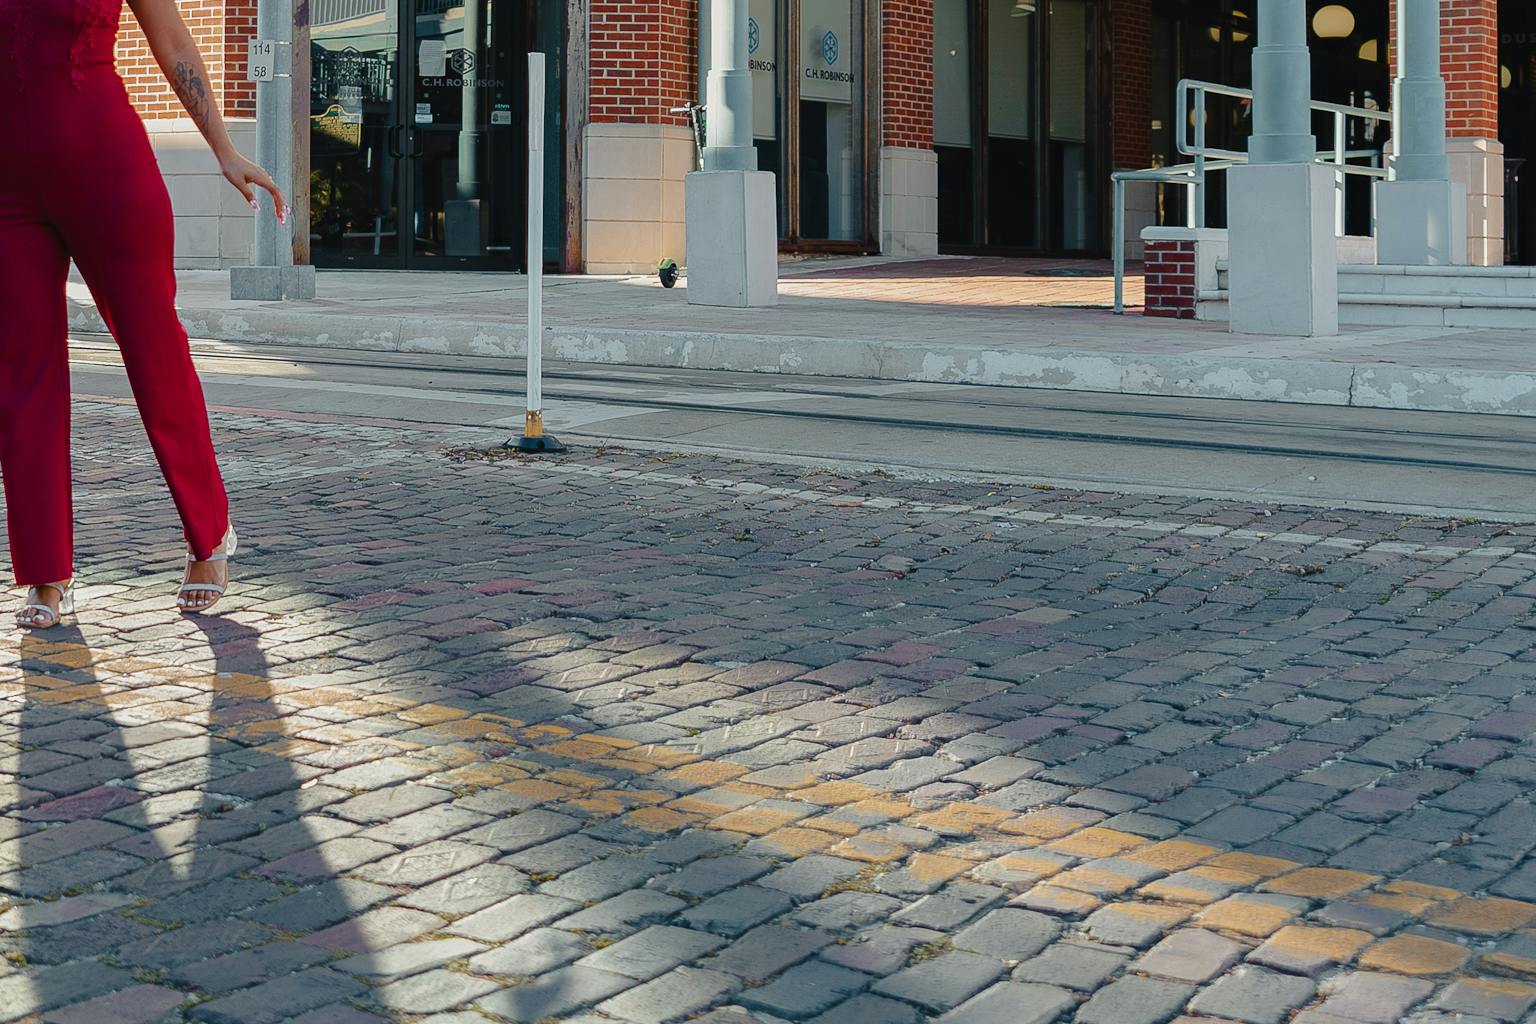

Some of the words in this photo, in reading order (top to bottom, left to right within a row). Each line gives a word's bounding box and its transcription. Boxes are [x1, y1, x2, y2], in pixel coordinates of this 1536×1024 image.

[253, 42, 270, 55] 114
[254, 66, 267, 77] 58
[805, 68, 819, 79] C.H.
[820, 70, 855, 83] ROBINSON
[422, 78, 444, 87] C.H.
[446, 78, 504, 88] ROBINSON
